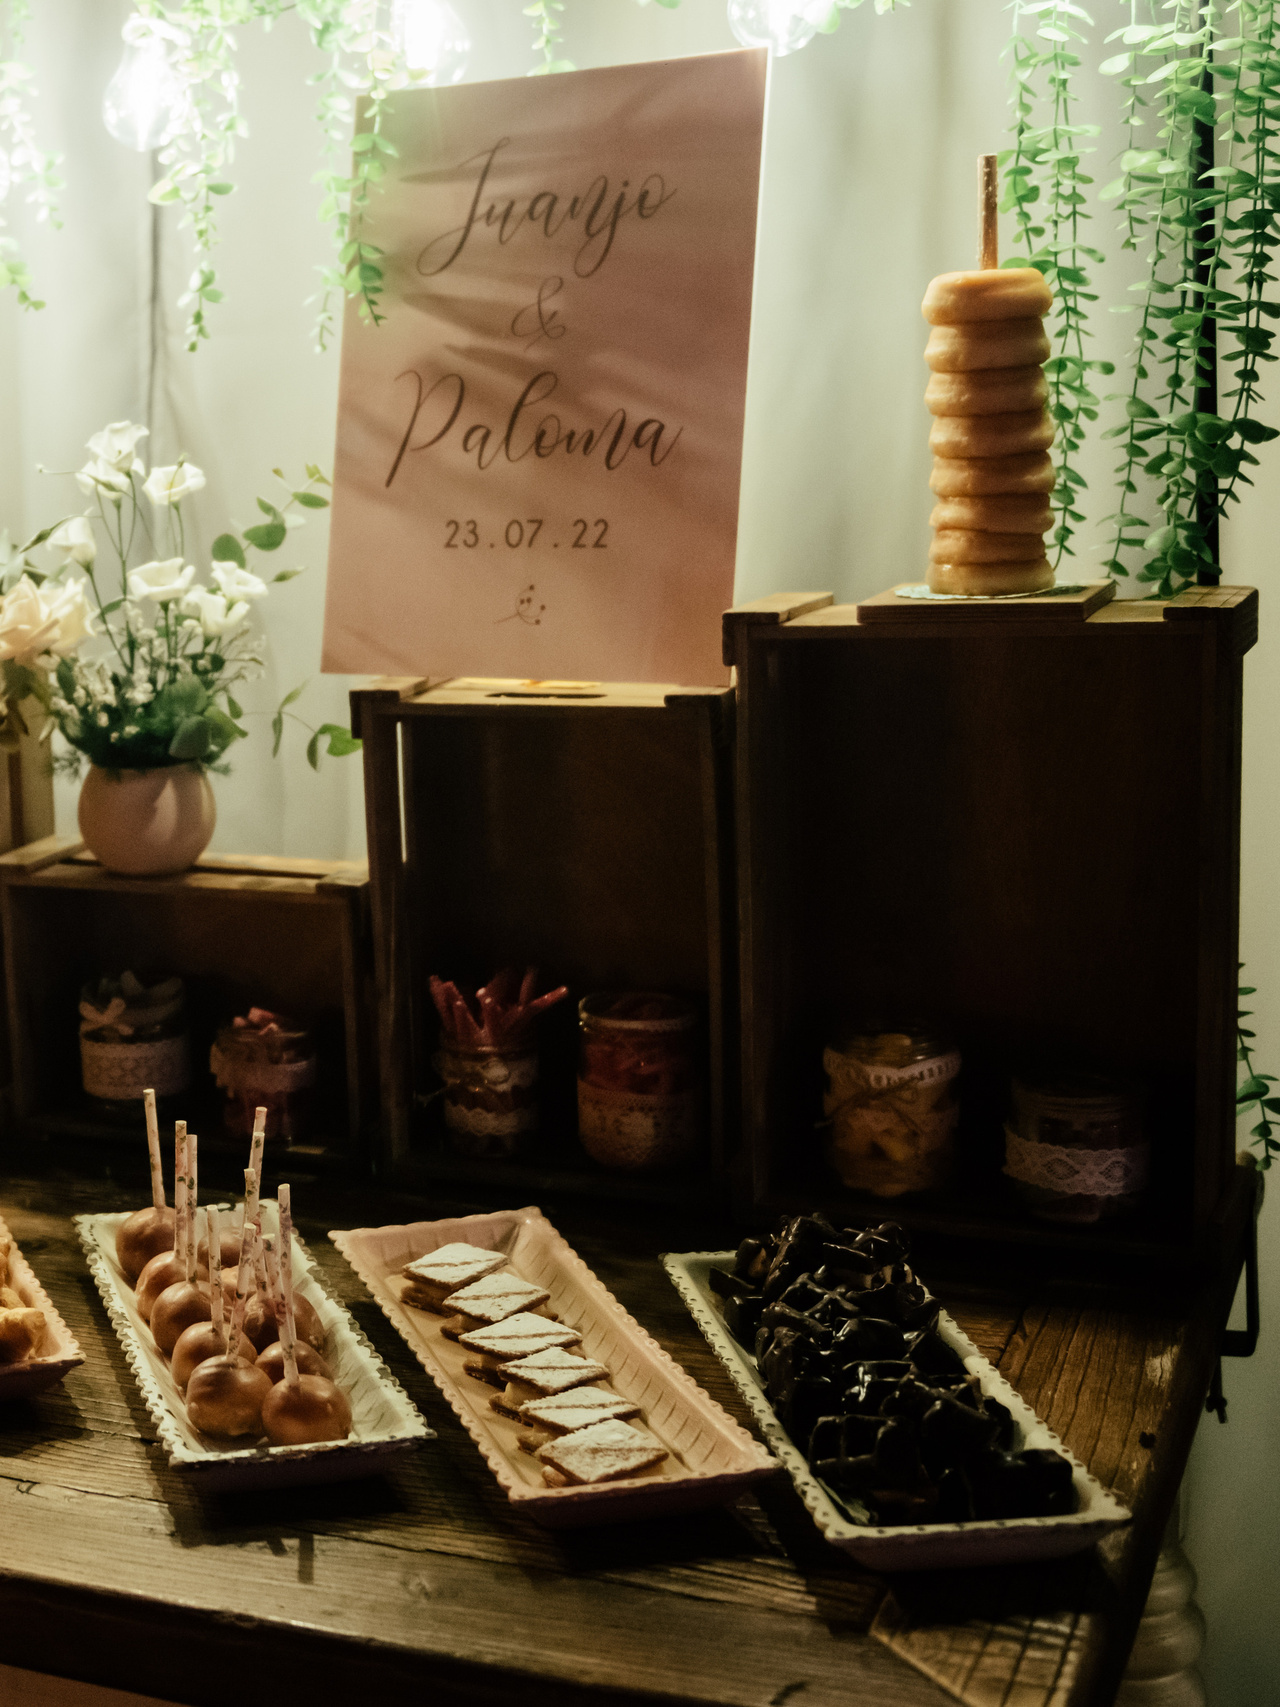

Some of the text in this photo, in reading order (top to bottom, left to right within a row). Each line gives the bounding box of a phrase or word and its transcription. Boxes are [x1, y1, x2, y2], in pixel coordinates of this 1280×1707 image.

[416, 136, 678, 279] Juanjo
[510, 275, 567, 351] &
[385, 369, 684, 488] Paloma
